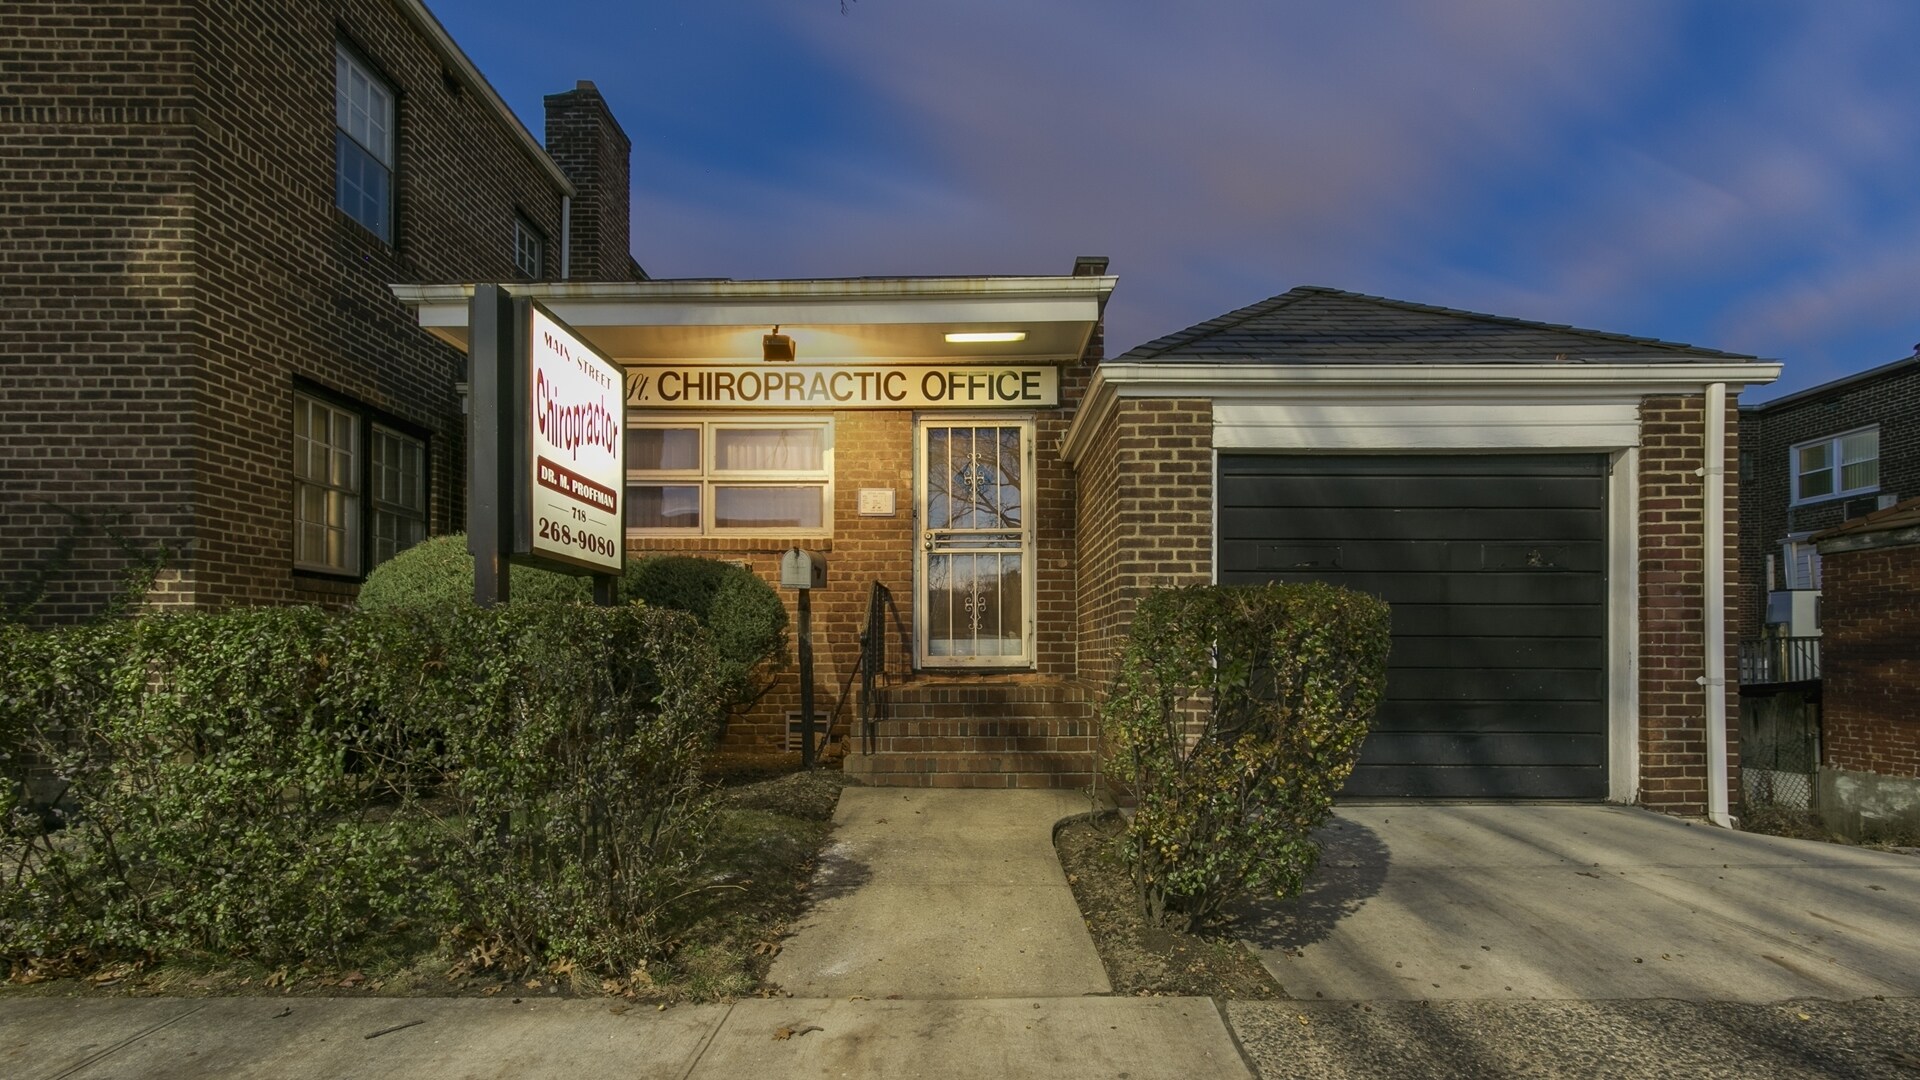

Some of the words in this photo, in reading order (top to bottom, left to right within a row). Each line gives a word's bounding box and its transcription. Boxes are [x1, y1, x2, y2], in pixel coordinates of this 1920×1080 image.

[544, 331, 570, 362] MAIN
[577, 356, 611, 390] STREET
[657, 370, 908, 402] CHIROPRACTIC
[921, 370, 1042, 402] OFFICE
[537, 367, 618, 461] Chiropractor
[541, 465, 557, 485] DR.
[559, 474, 570, 490] M.
[572, 479, 614, 509] PROFFMAN
[571, 506, 587, 523] 718
[539, 517, 615, 558] 268-9080
